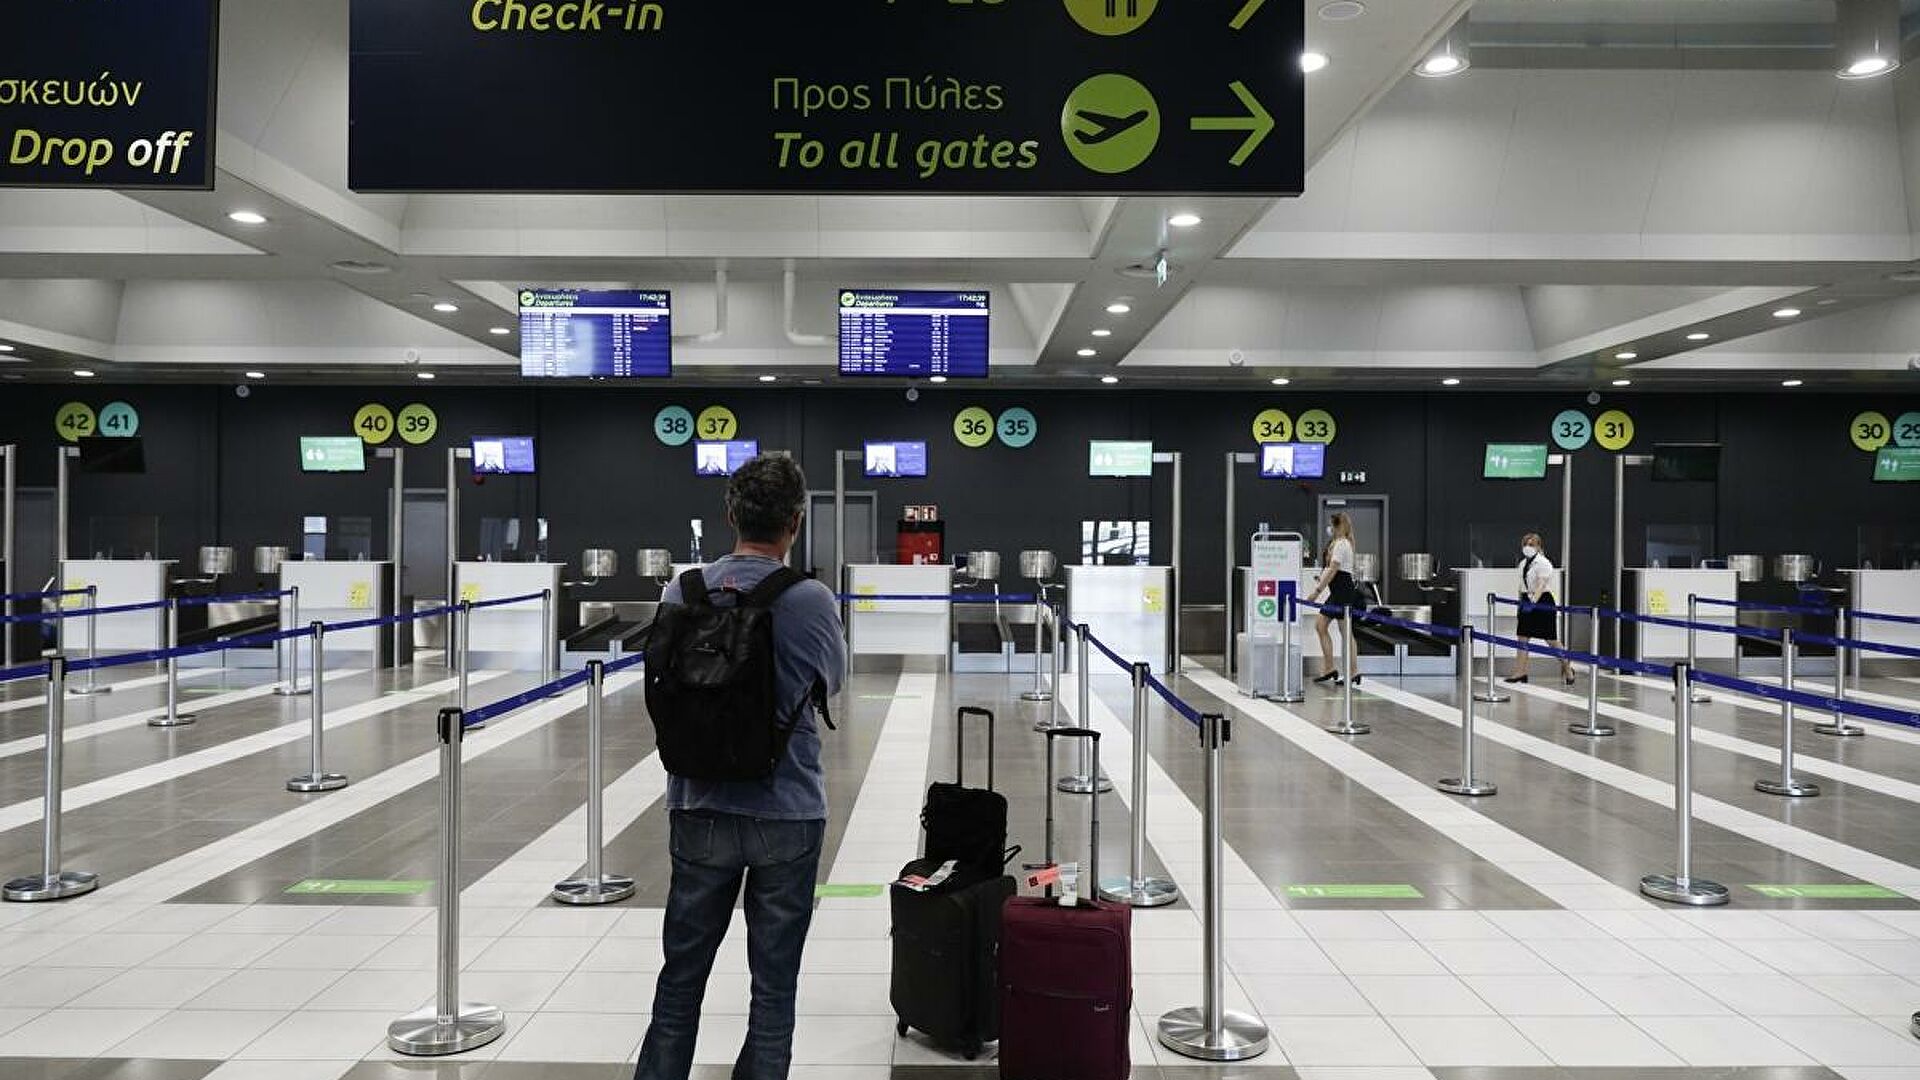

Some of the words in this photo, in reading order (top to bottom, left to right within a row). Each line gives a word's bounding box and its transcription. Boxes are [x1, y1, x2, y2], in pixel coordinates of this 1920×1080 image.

[471, 0, 664, 31] Check-in
[0, 71, 142, 107] σκευών
[773, 76, 871, 118] Προς
[885, 75, 1004, 110] Πύλες
[9, 128, 114, 176] Drop
[127, 130, 194, 174] off
[774, 132, 825, 168] To
[839, 132, 898, 169] all
[916, 134, 1039, 178] gates
[61, 413, 90, 431] 42
[106, 413, 130, 431] 41
[360, 415, 388, 433] 40
[405, 415, 430, 433] 39
[661, 417, 688, 435] 38
[704, 417, 730, 435] 37
[960, 418, 987, 436] 36
[1003, 418, 1029, 436] 35
[1259, 420, 1285, 438] 34
[1303, 420, 1328, 438] 33
[1559, 421, 1585, 439] 32
[1603, 421, 1626, 439] 31
[1857, 422, 1884, 440] 30
